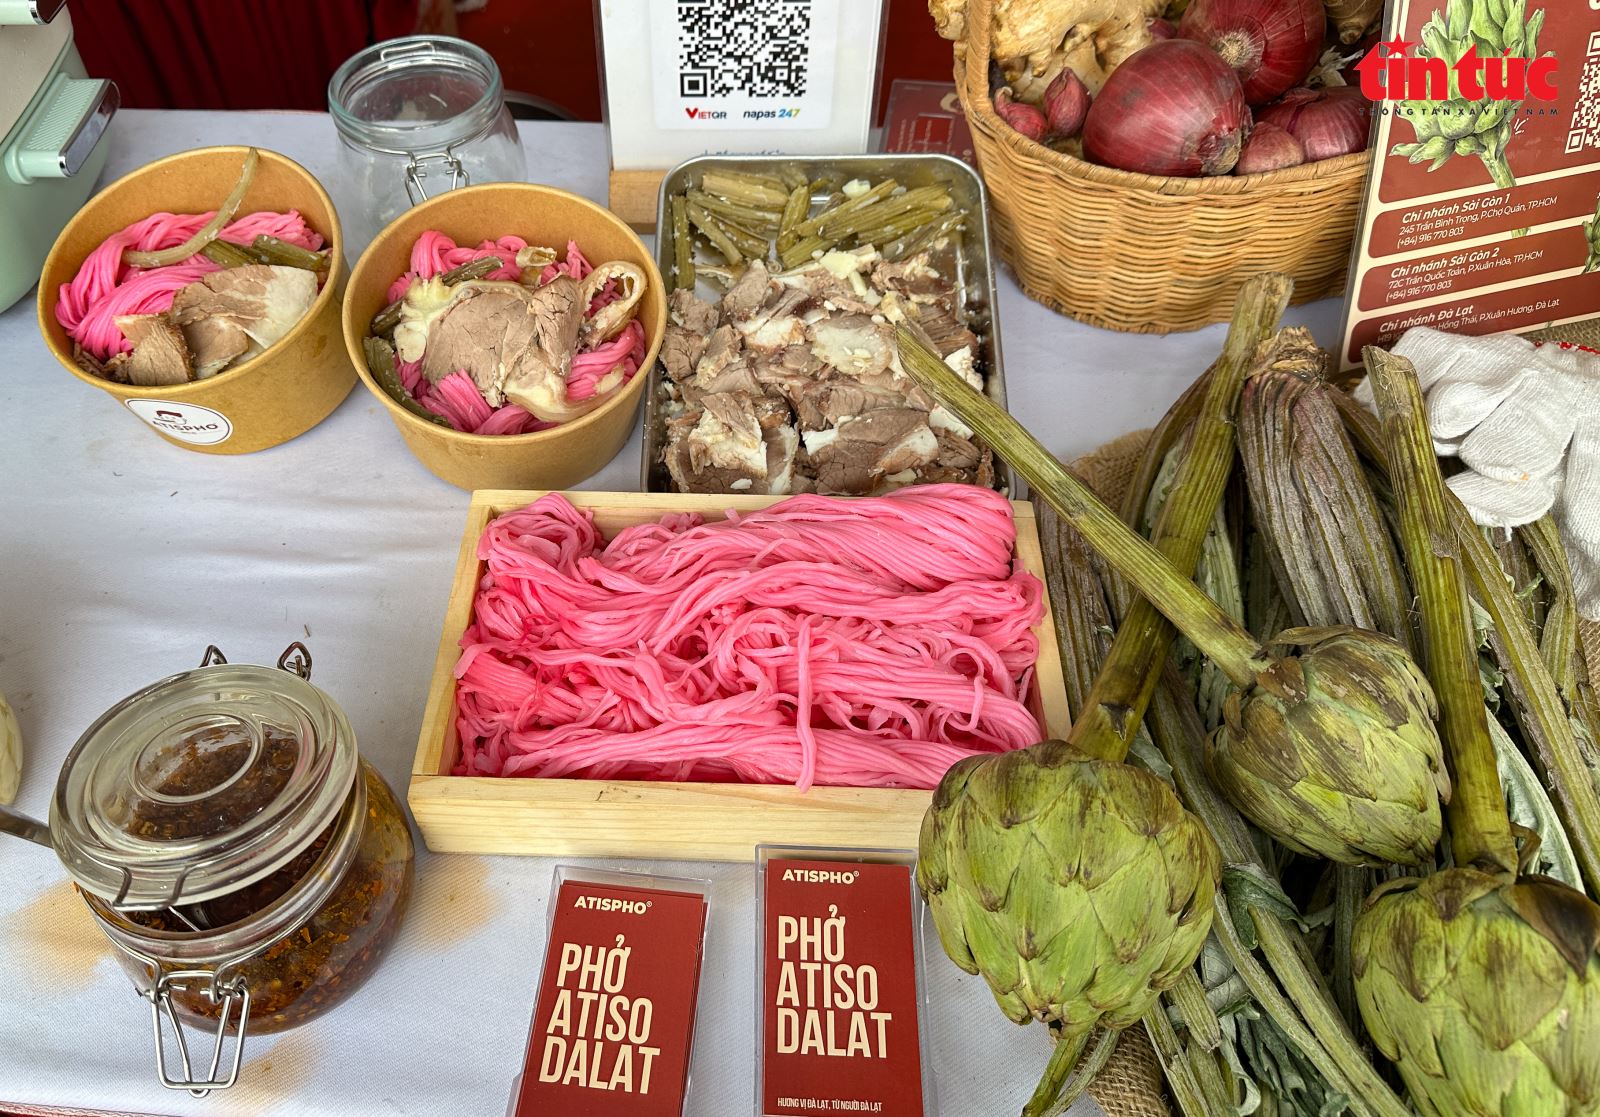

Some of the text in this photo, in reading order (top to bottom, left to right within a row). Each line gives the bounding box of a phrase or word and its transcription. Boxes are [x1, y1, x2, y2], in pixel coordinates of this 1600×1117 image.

[743, 108, 801, 120] napas 247
[1402, 193, 1511, 224] Chi nhánh Sài Gòn 1
[1397, 226, 1464, 249] (+84) 916 770 803
[1399, 225, 1415, 236] 245
[1391, 247, 1500, 278] Chi nhánh Sài Gòn 2
[1386, 280, 1452, 303] (+84) 916 770 803
[1388, 279, 1404, 289] 72C
[1424, 271, 1446, 282] Quốc
[1380, 320, 1399, 333] Chi
[1400, 313, 1435, 329] nhánh
[1437, 309, 1454, 320] Đà
[1456, 305, 1474, 317] Lạt
[777, 904, 846, 962] PHỞ
[556, 933, 632, 994] PHỞ
[776, 961, 879, 1011] ATISO
[546, 989, 654, 1045] ATISO
[776, 1007, 892, 1059] DALAT
[538, 1035, 661, 1095] DALAT
[800, 1098, 807, 1110] VỊ
[807, 1097, 816, 1109] ĐÀ
[817, 1099, 831, 1111] LẠT,
[860, 1100, 869, 1111] ĐÀ
[870, 1102, 882, 1113] LẠT
